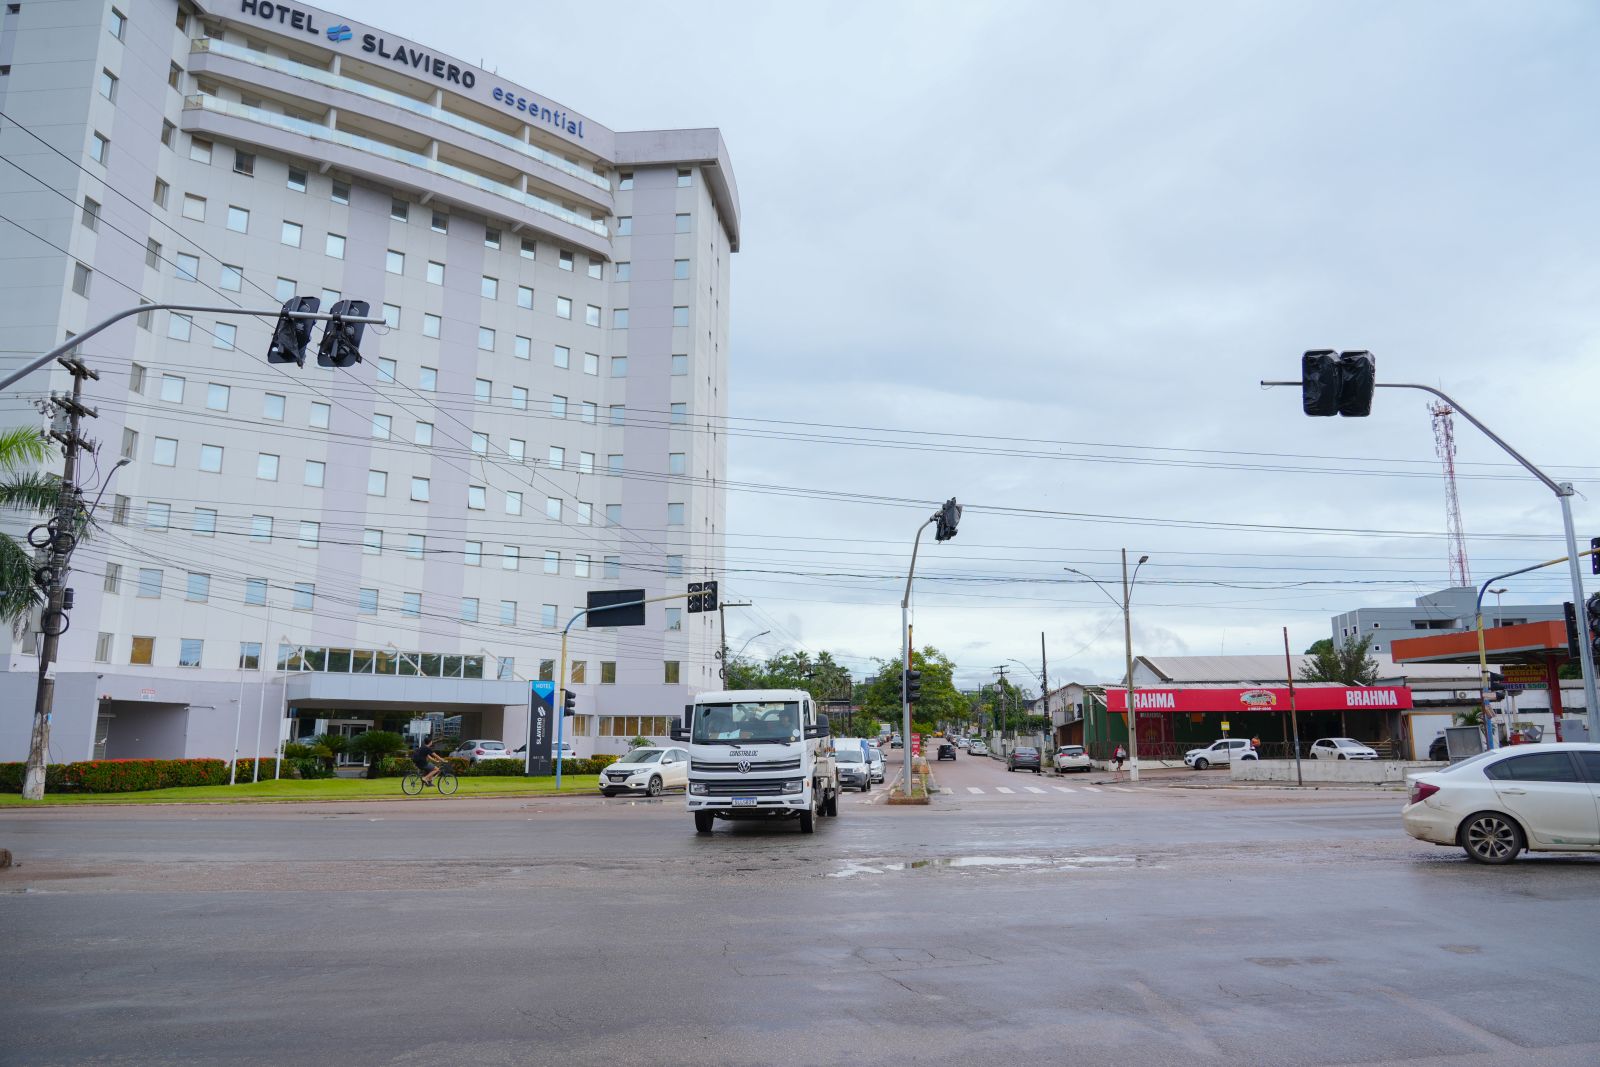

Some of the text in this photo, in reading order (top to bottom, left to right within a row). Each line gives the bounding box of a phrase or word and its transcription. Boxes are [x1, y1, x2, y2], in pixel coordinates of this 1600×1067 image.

[241, 0, 585, 139] HOTEL SLAVIERO essential
[535, 682, 551, 690] HOTEL
[1346, 689, 1398, 707] BRAHMA
